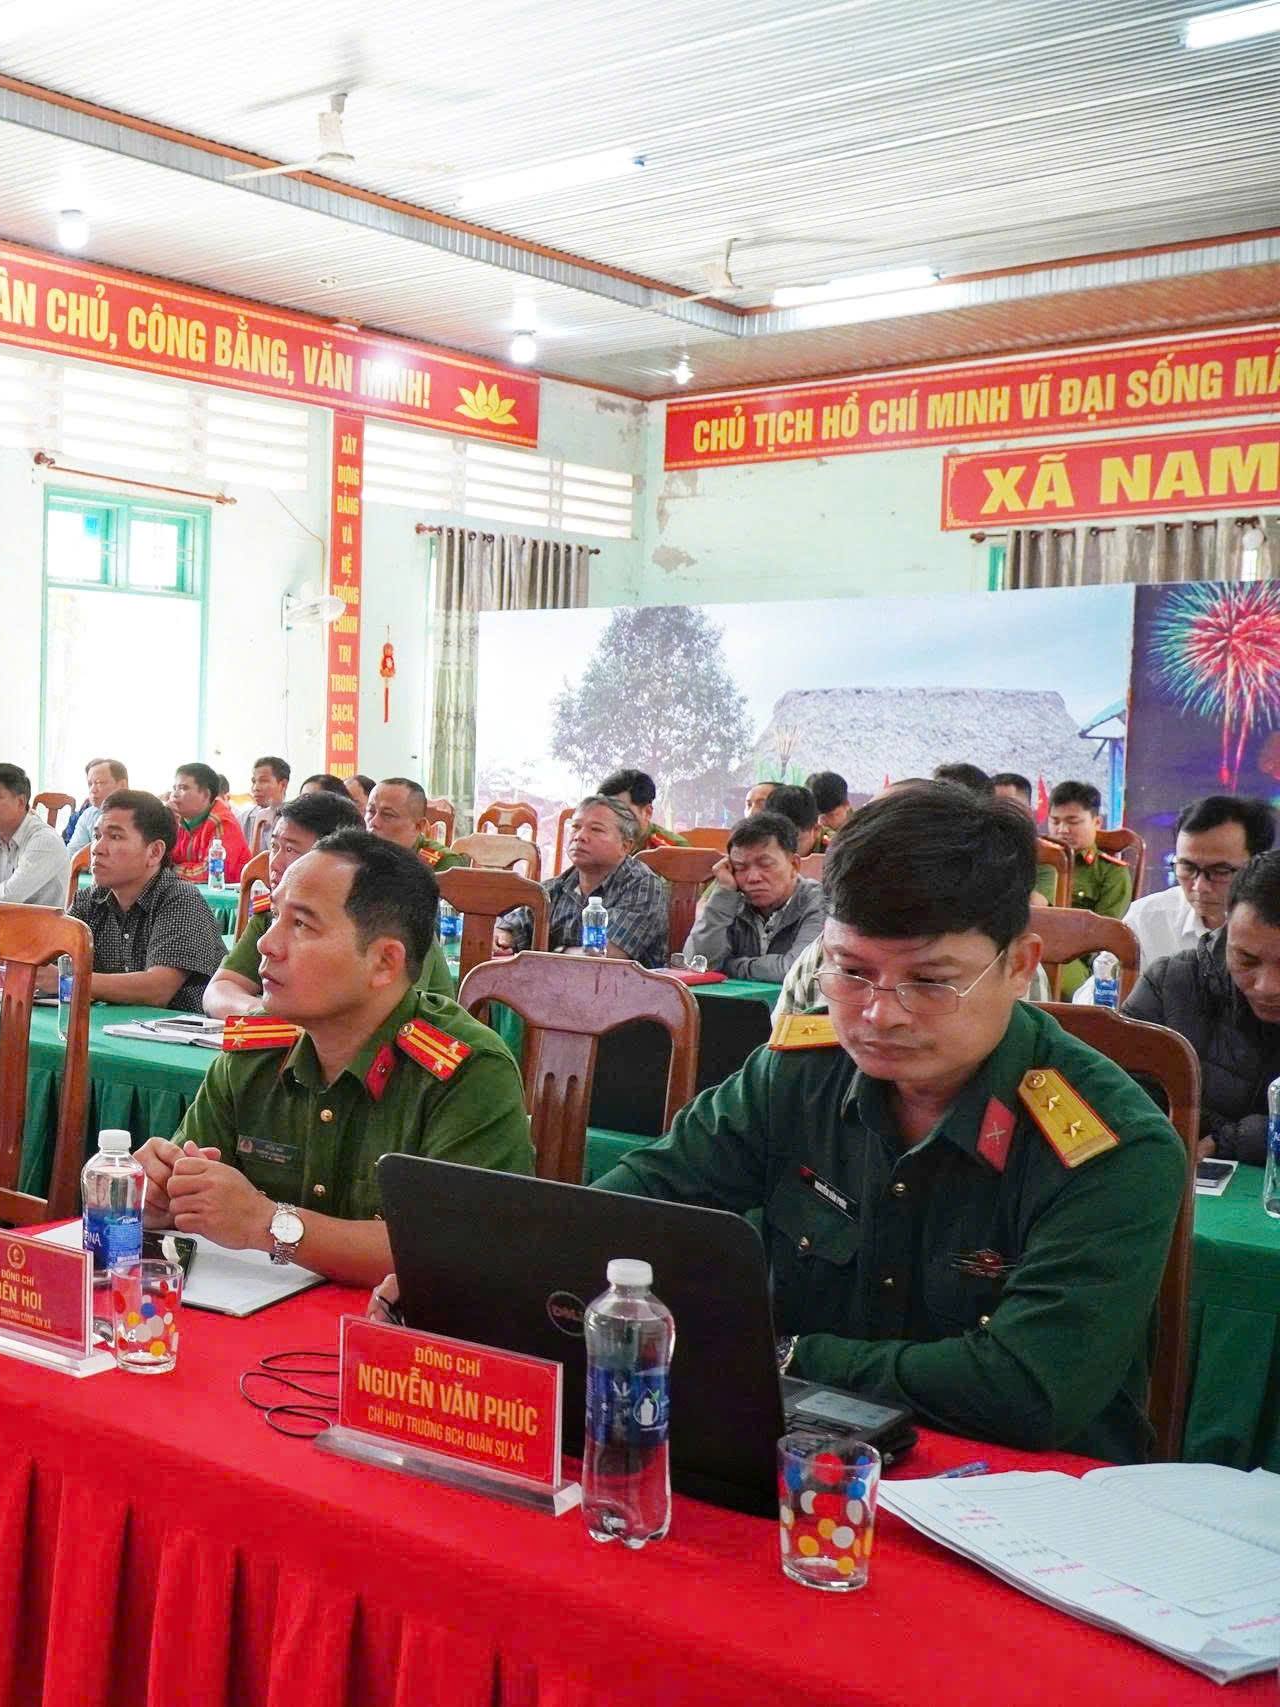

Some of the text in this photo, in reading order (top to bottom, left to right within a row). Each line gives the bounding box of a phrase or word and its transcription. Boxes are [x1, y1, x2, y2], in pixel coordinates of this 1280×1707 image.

[46, 284, 117, 349] CHỦ,
[128, 303, 206, 363] CÔNG
[215, 314, 294, 386] BẰNG,
[303, 341, 353, 393] VĂN
[360, 358, 431, 409] MINH!
[693, 405, 745, 453] CHỦ
[753, 408, 814, 453] TỊCH
[821, 391, 860, 440] HỒ
[868, 389, 918, 436] CHÍ
[927, 386, 1010, 430] MINH
[1020, 373, 1053, 420] VĨ
[1059, 373, 1116, 422] ĐẠI
[1126, 352, 1223, 408] SỐNG
[980, 442, 1280, 515] XÃ NAM
[22, 1288, 41, 1310] HOI
[415, 1345, 480, 1377] ĐỒNG CHÍ
[358, 1363, 435, 1409] NGUYỄN
[440, 1382, 480, 1421] VĂN
[484, 1395, 538, 1436] PHÚC
[385, 1408, 404, 1429] HUY
[445, 1426, 464, 1447] BCH
[466, 1432, 494, 1454] QUÂN
